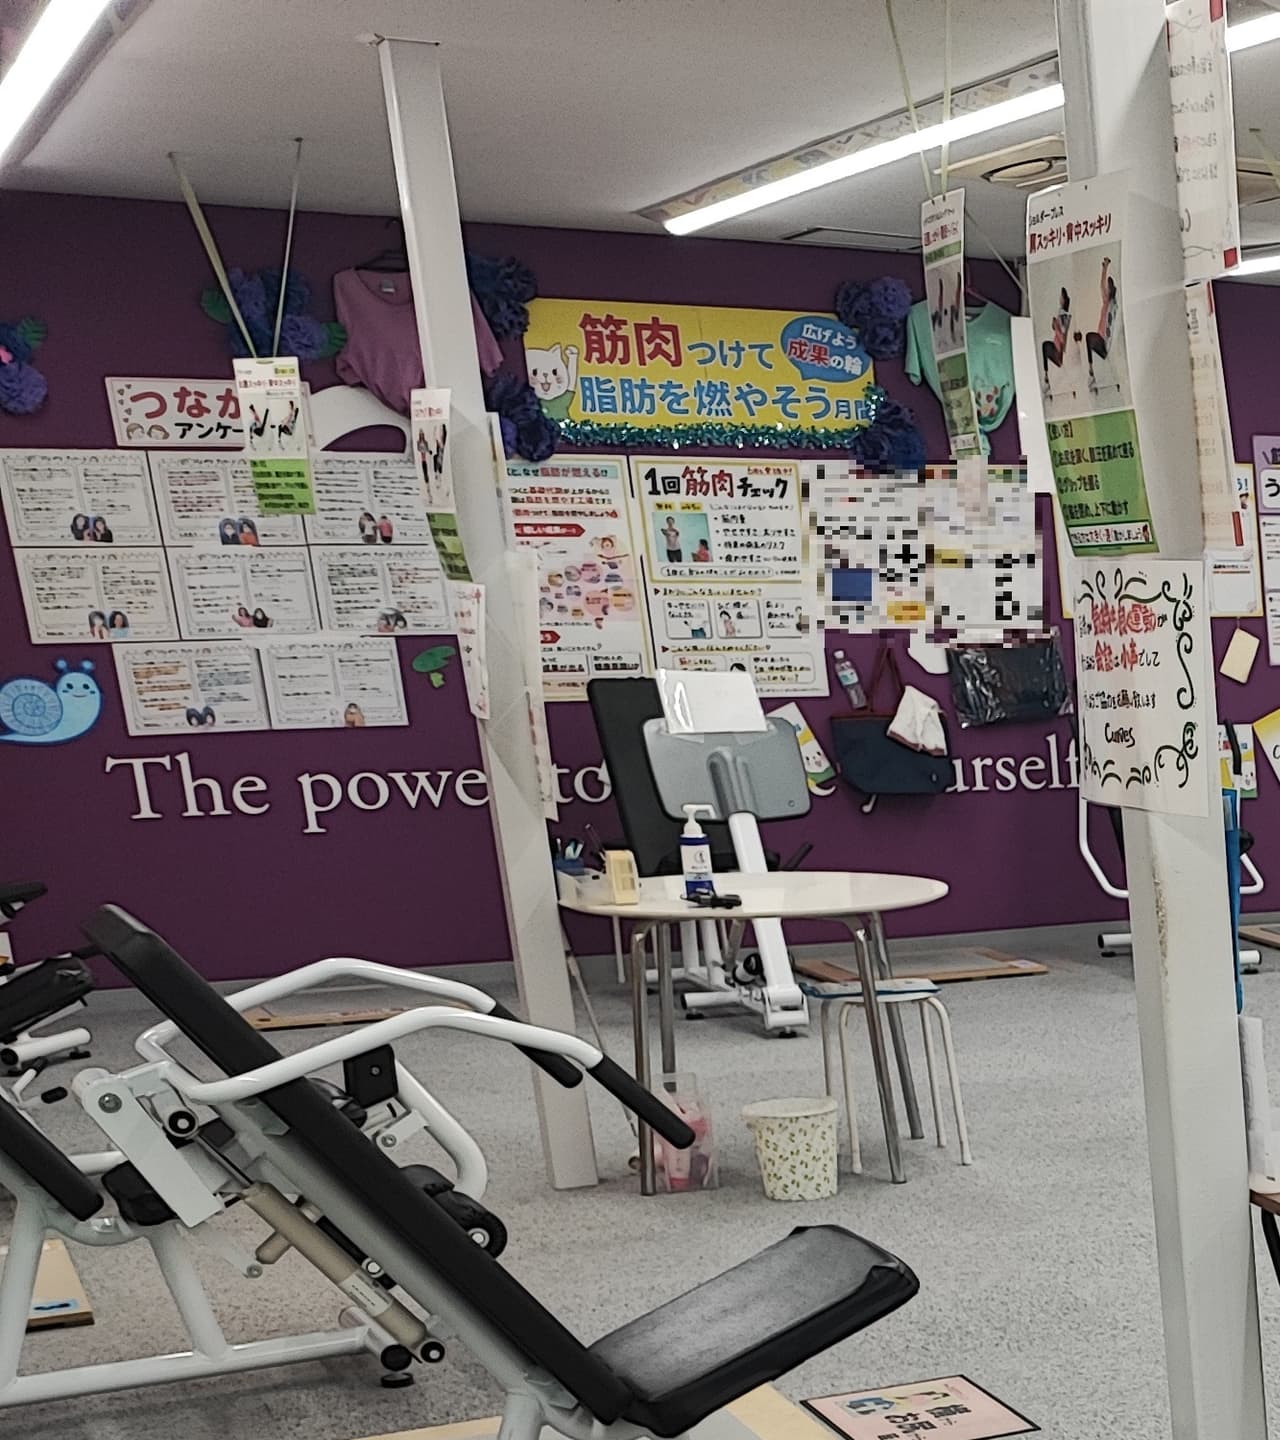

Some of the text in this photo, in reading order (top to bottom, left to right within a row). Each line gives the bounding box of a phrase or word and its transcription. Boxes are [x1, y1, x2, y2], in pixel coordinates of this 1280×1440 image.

[801, 323, 858, 350] 広げよう
[787, 339, 864, 375] 成果の輪
[1104, 723, 1136, 748] Curves
[106, 752, 270, 820] The
[297, 767, 490, 834] powe
[947, 733, 1080, 794] urself
